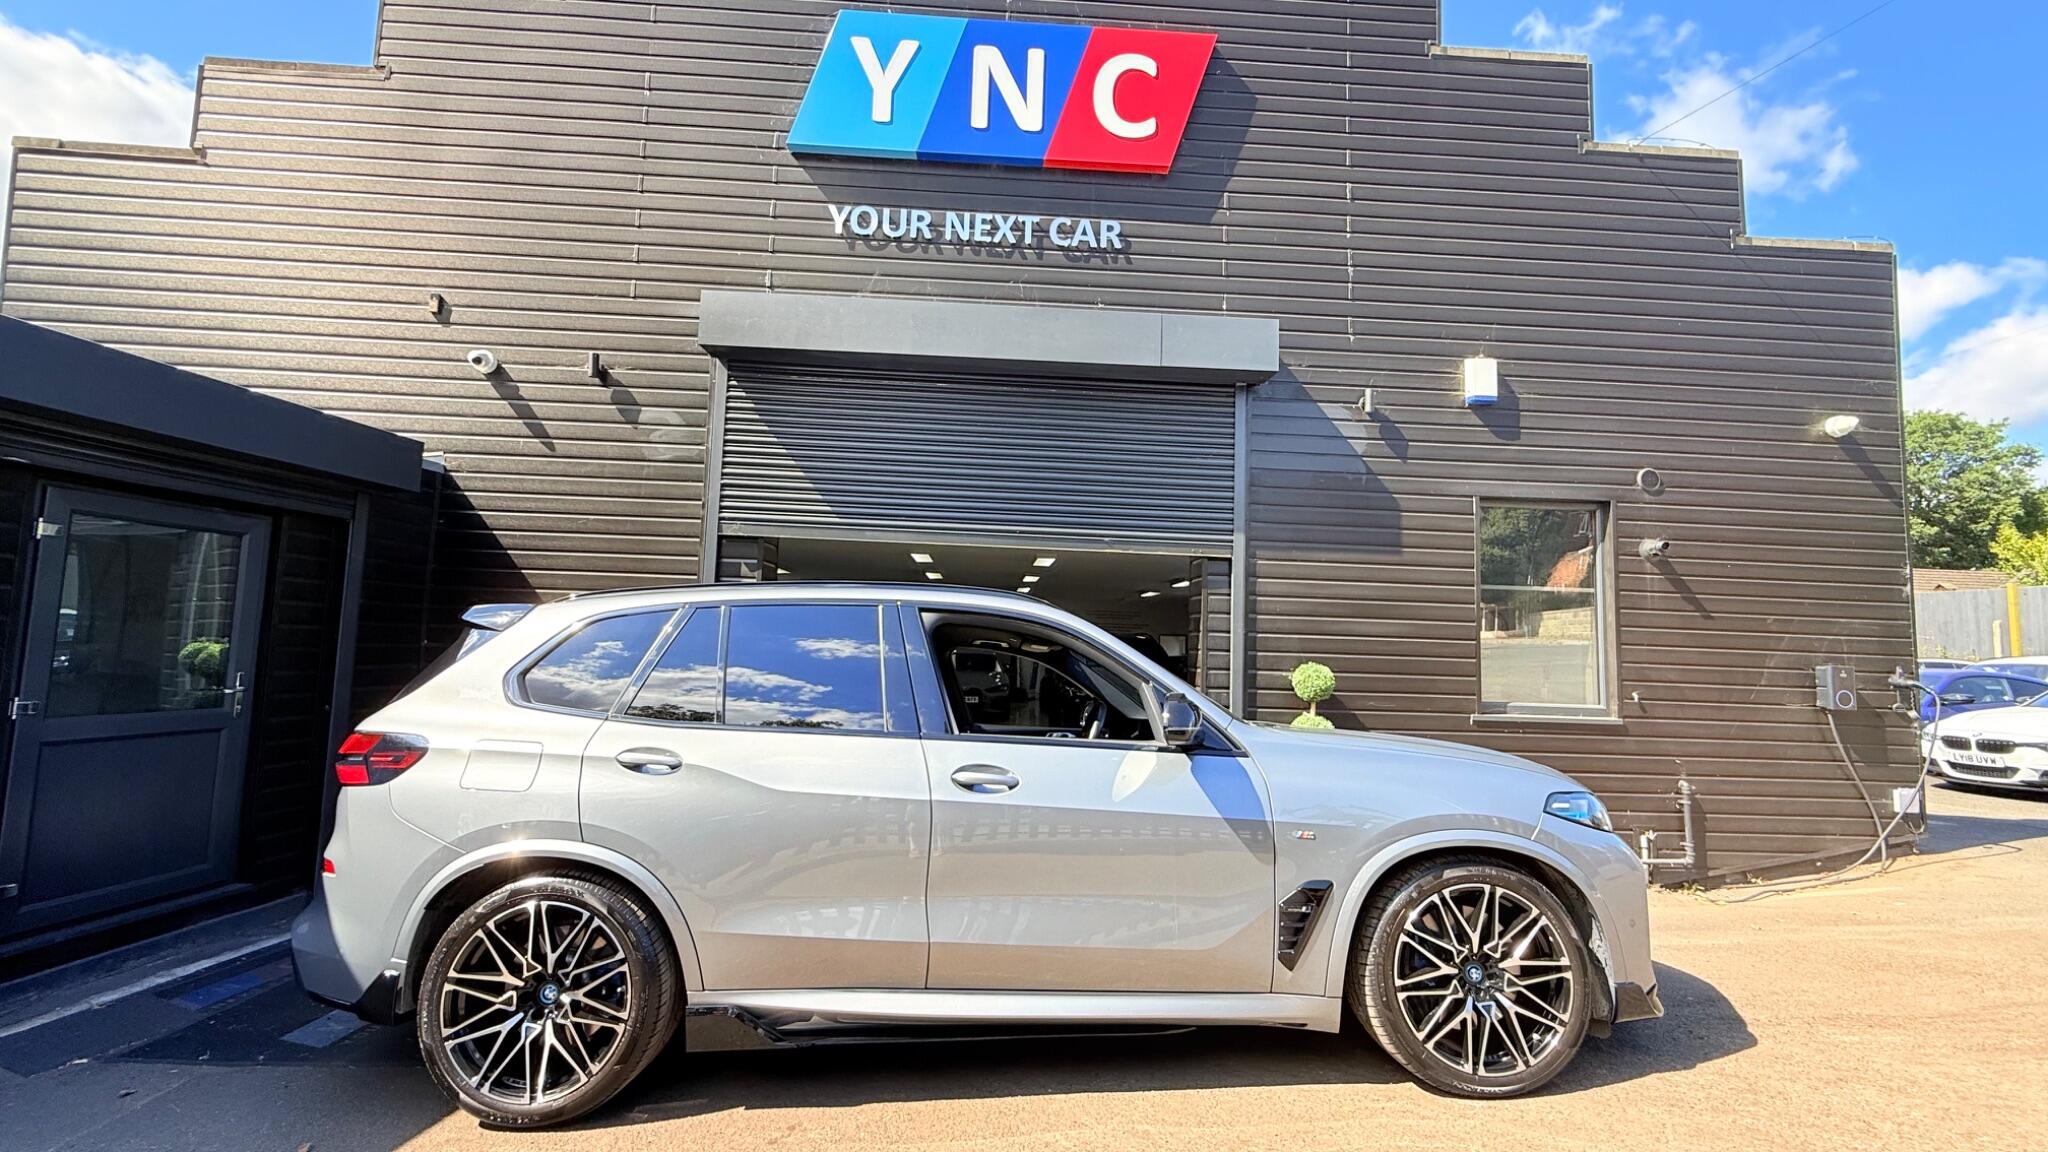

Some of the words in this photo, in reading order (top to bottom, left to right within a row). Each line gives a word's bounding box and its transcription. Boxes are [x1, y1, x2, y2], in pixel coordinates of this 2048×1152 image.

[850, 36, 1159, 139] YNC
[828, 204, 932, 240] YOUR
[944, 211, 1041, 245] NEXT
[1049, 217, 1122, 249] CAR
[1953, 753, 1974, 762] LY18
[1976, 755, 1997, 764] UVW
